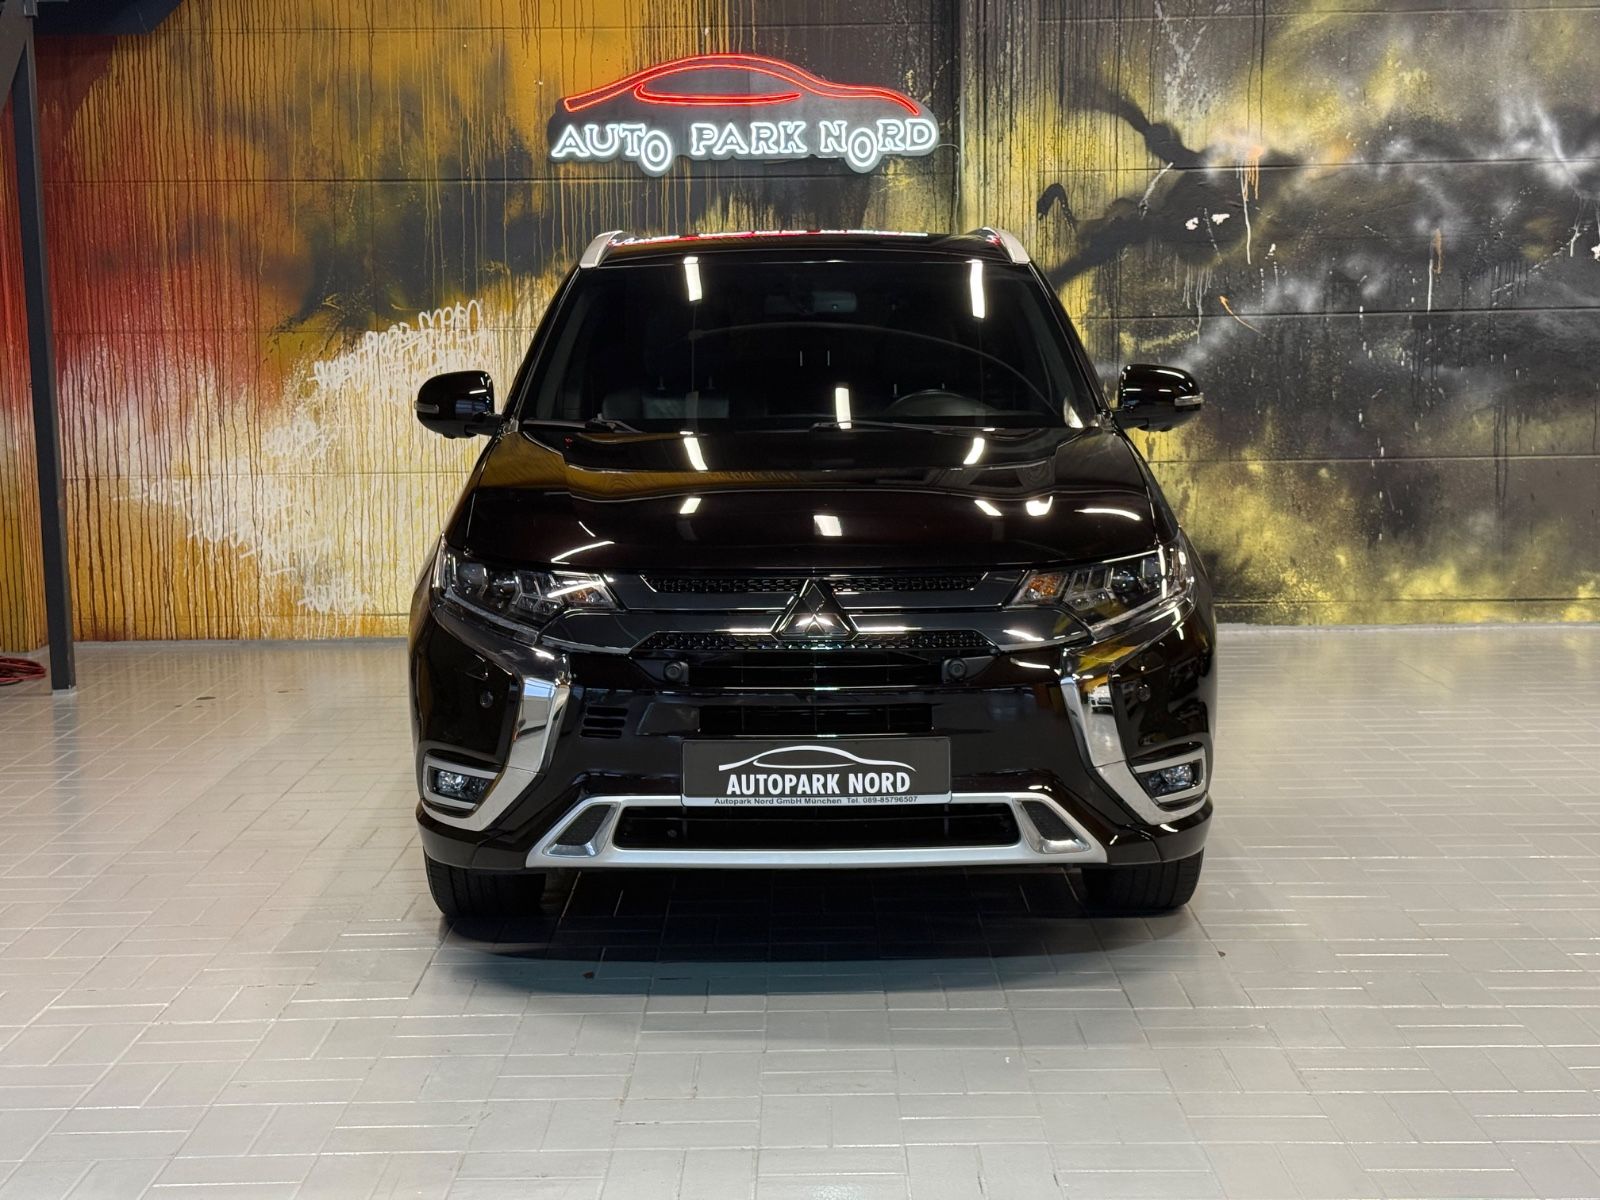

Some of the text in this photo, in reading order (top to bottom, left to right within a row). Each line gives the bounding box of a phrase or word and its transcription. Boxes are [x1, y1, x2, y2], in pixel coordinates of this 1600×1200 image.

[551, 118, 937, 172] AUTO PARK NORD
[726, 772, 911, 795] AUTOPARK NORD
[714, 798, 752, 806] Autopark
[754, 797, 774, 806] Nord
[776, 797, 802, 805] GmbH
[804, 796, 842, 805] München
[862, 795, 918, 804] 089-85796507
